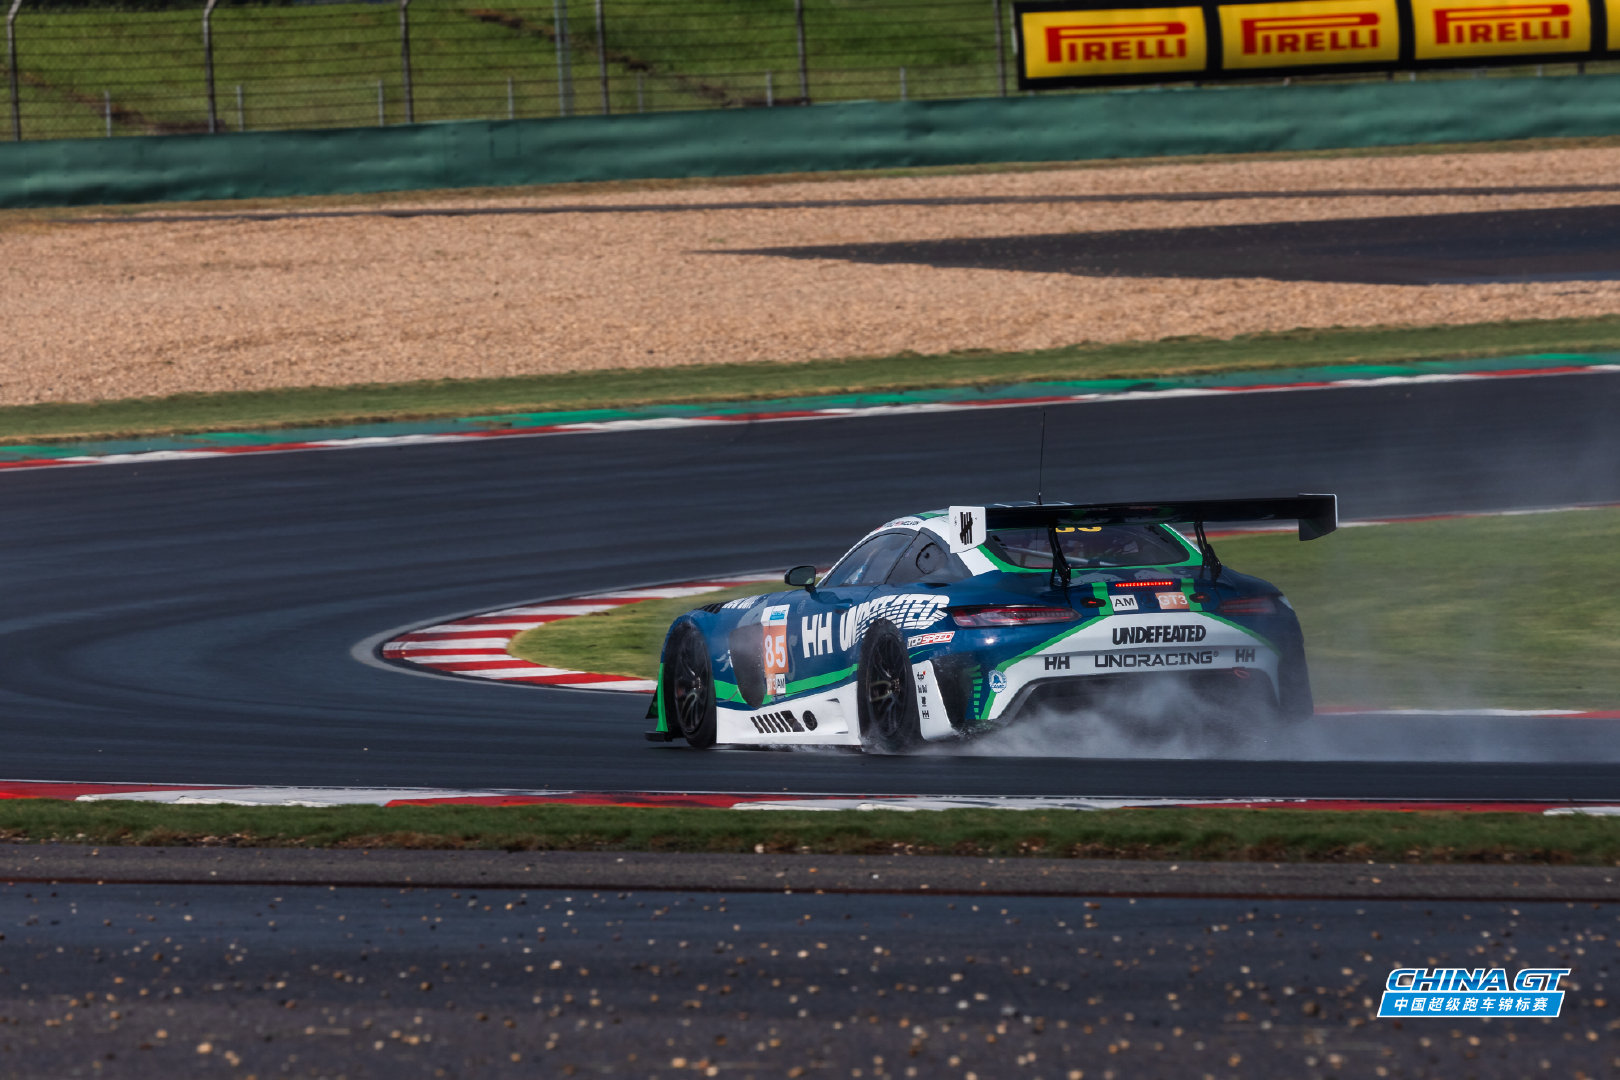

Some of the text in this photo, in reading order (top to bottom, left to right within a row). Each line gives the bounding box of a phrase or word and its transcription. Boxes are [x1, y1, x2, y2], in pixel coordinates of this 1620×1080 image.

[1241, 12, 1380, 55] PIRELLI
[1433, 4, 1571, 45] PIRELLI
[1045, 22, 1187, 63] PIRELLI
[1114, 595, 1135, 607] AM
[1158, 594, 1188, 606] GT3
[802, 612, 833, 658] HH
[1112, 625, 1206, 645] UNDEFEATED
[765, 635, 786, 668] 85
[1045, 656, 1070, 670] HH
[1235, 649, 1255, 662] HH
